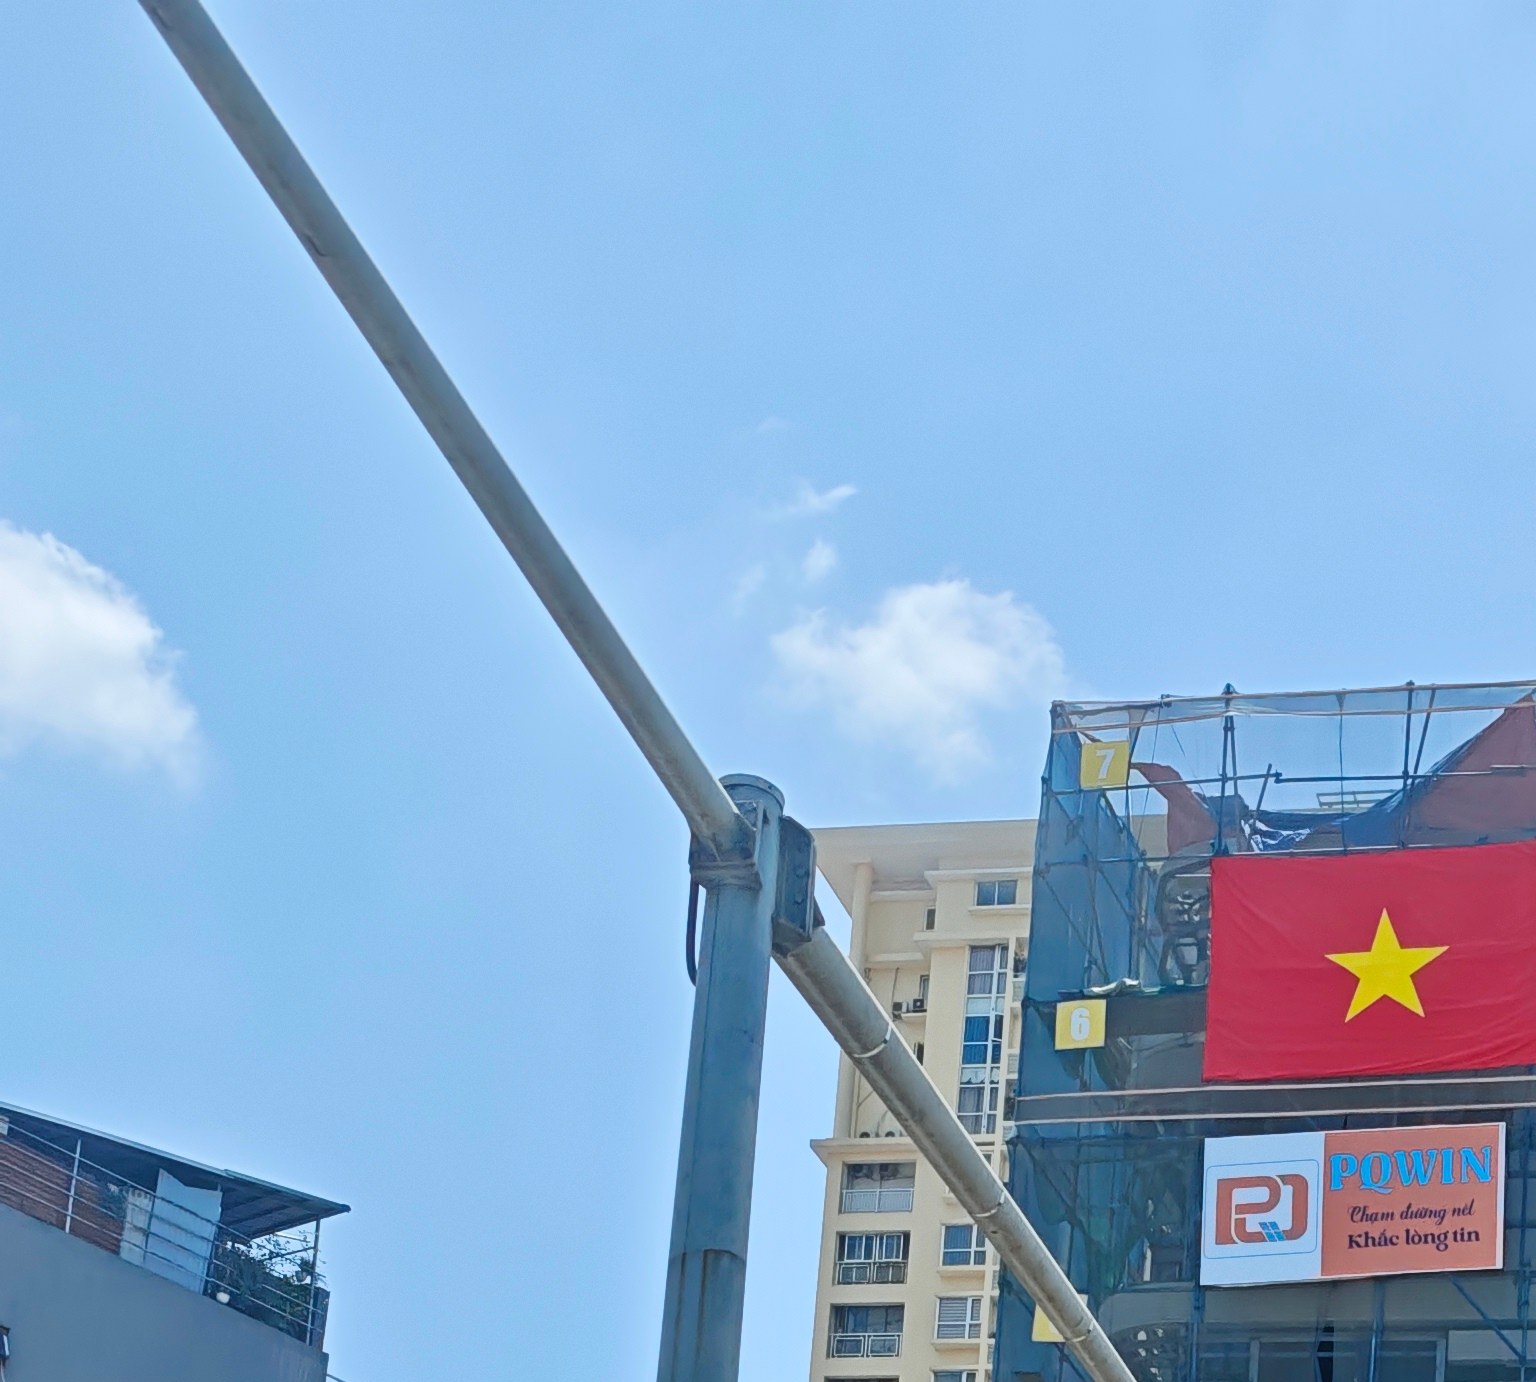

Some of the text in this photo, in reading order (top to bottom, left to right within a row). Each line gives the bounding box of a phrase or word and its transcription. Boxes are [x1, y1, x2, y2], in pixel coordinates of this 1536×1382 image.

[1095, 748, 1116, 780] 7
[1071, 1007, 1091, 1041] 6
[1329, 1145, 1493, 1196] PQWIN
[1347, 1205, 1395, 1224] Chạm
[1347, 1227, 1480, 1252] Khắc lòng tin
